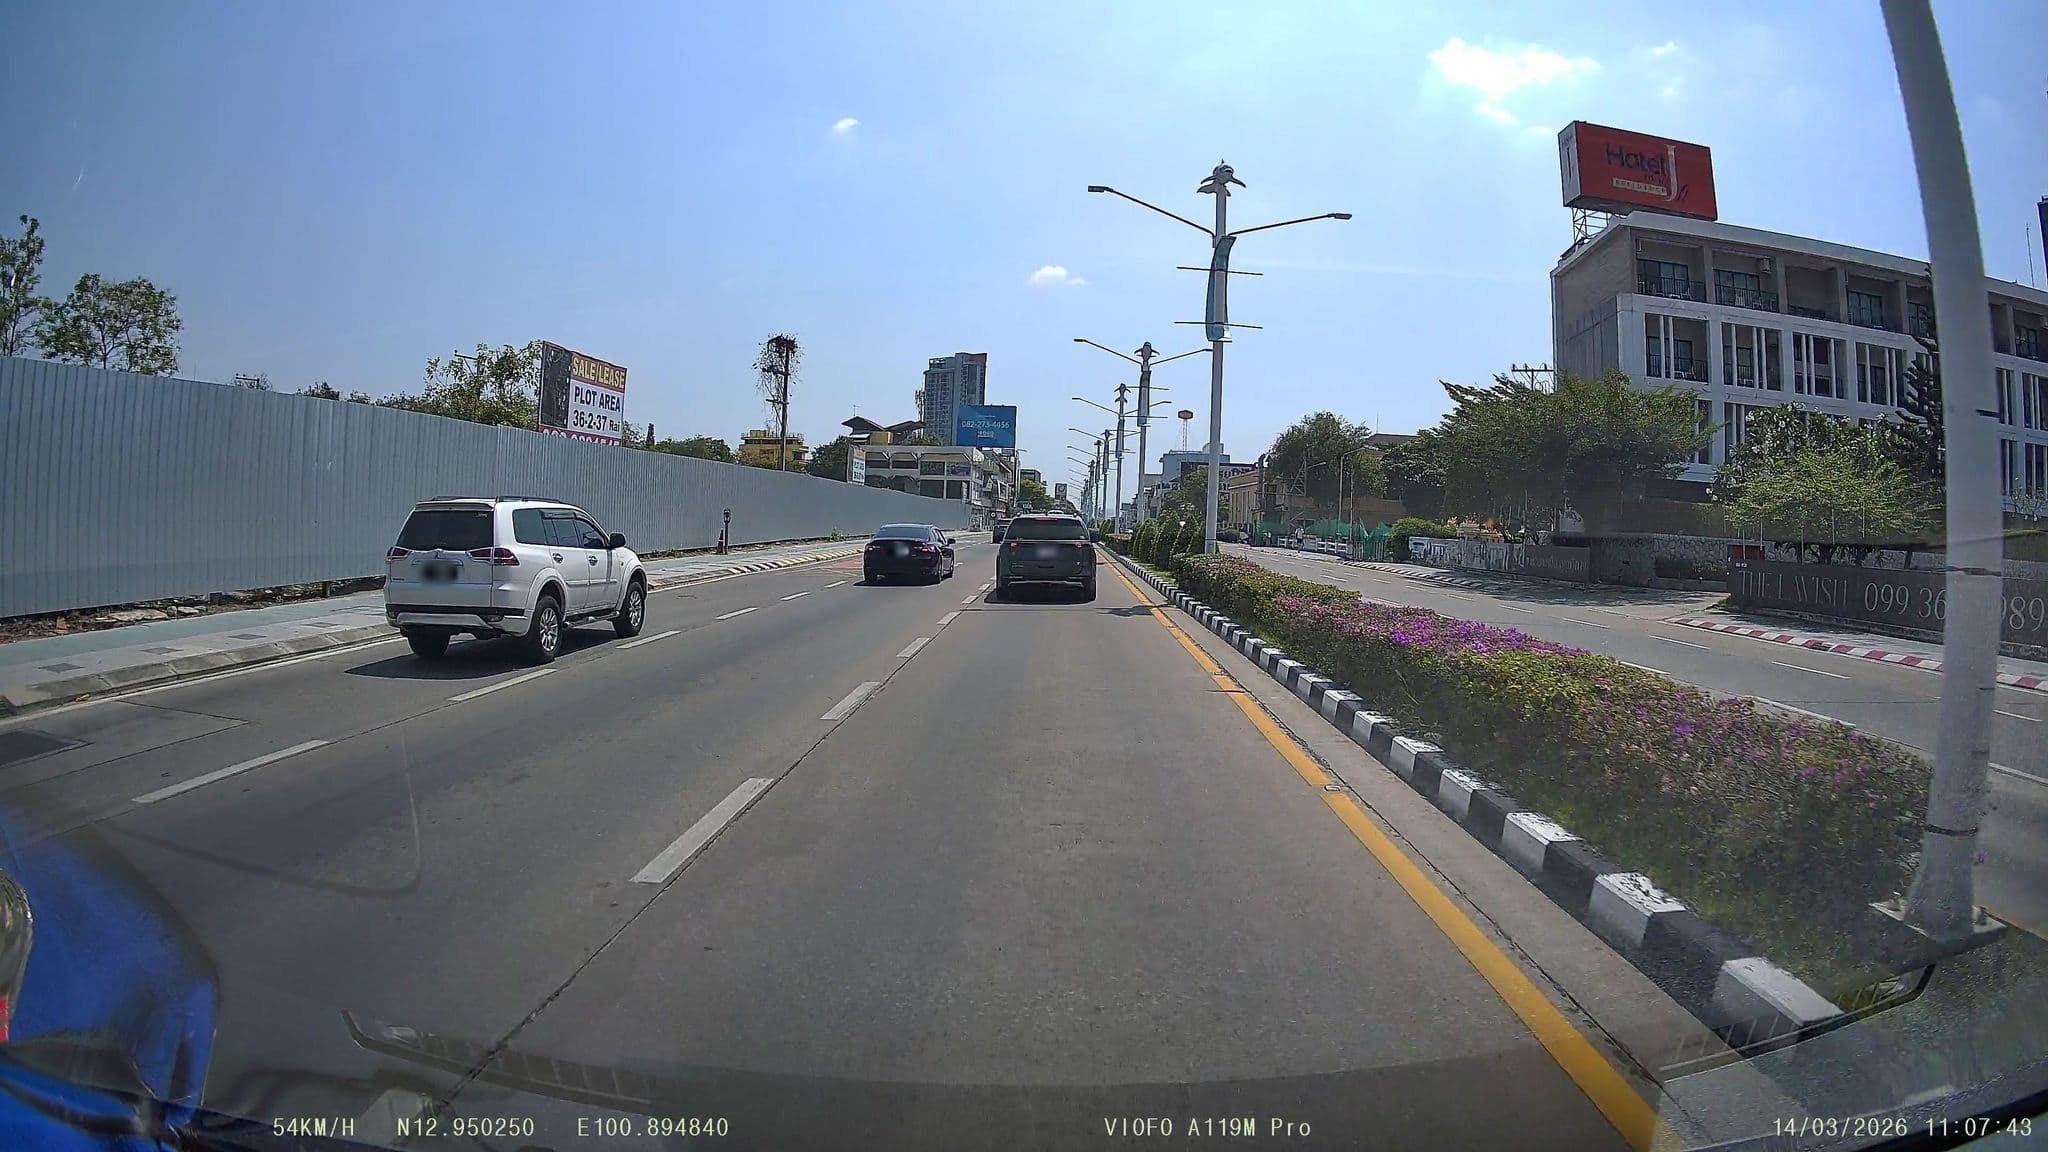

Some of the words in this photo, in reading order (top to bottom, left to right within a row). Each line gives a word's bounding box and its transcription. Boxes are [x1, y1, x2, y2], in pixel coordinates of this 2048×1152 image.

[1605, 143, 1665, 175] Hotel
[573, 358, 624, 388] SALE/LEASE
[574, 386, 597, 407] PLOT
[599, 393, 621, 412] AREA
[573, 410, 607, 431] 36-2-37
[609, 420, 620, 432] Rai
[1864, 582, 1910, 615] 099
[1918, 588, 1947, 620] 36
[2001, 595, 2045, 632] 89
